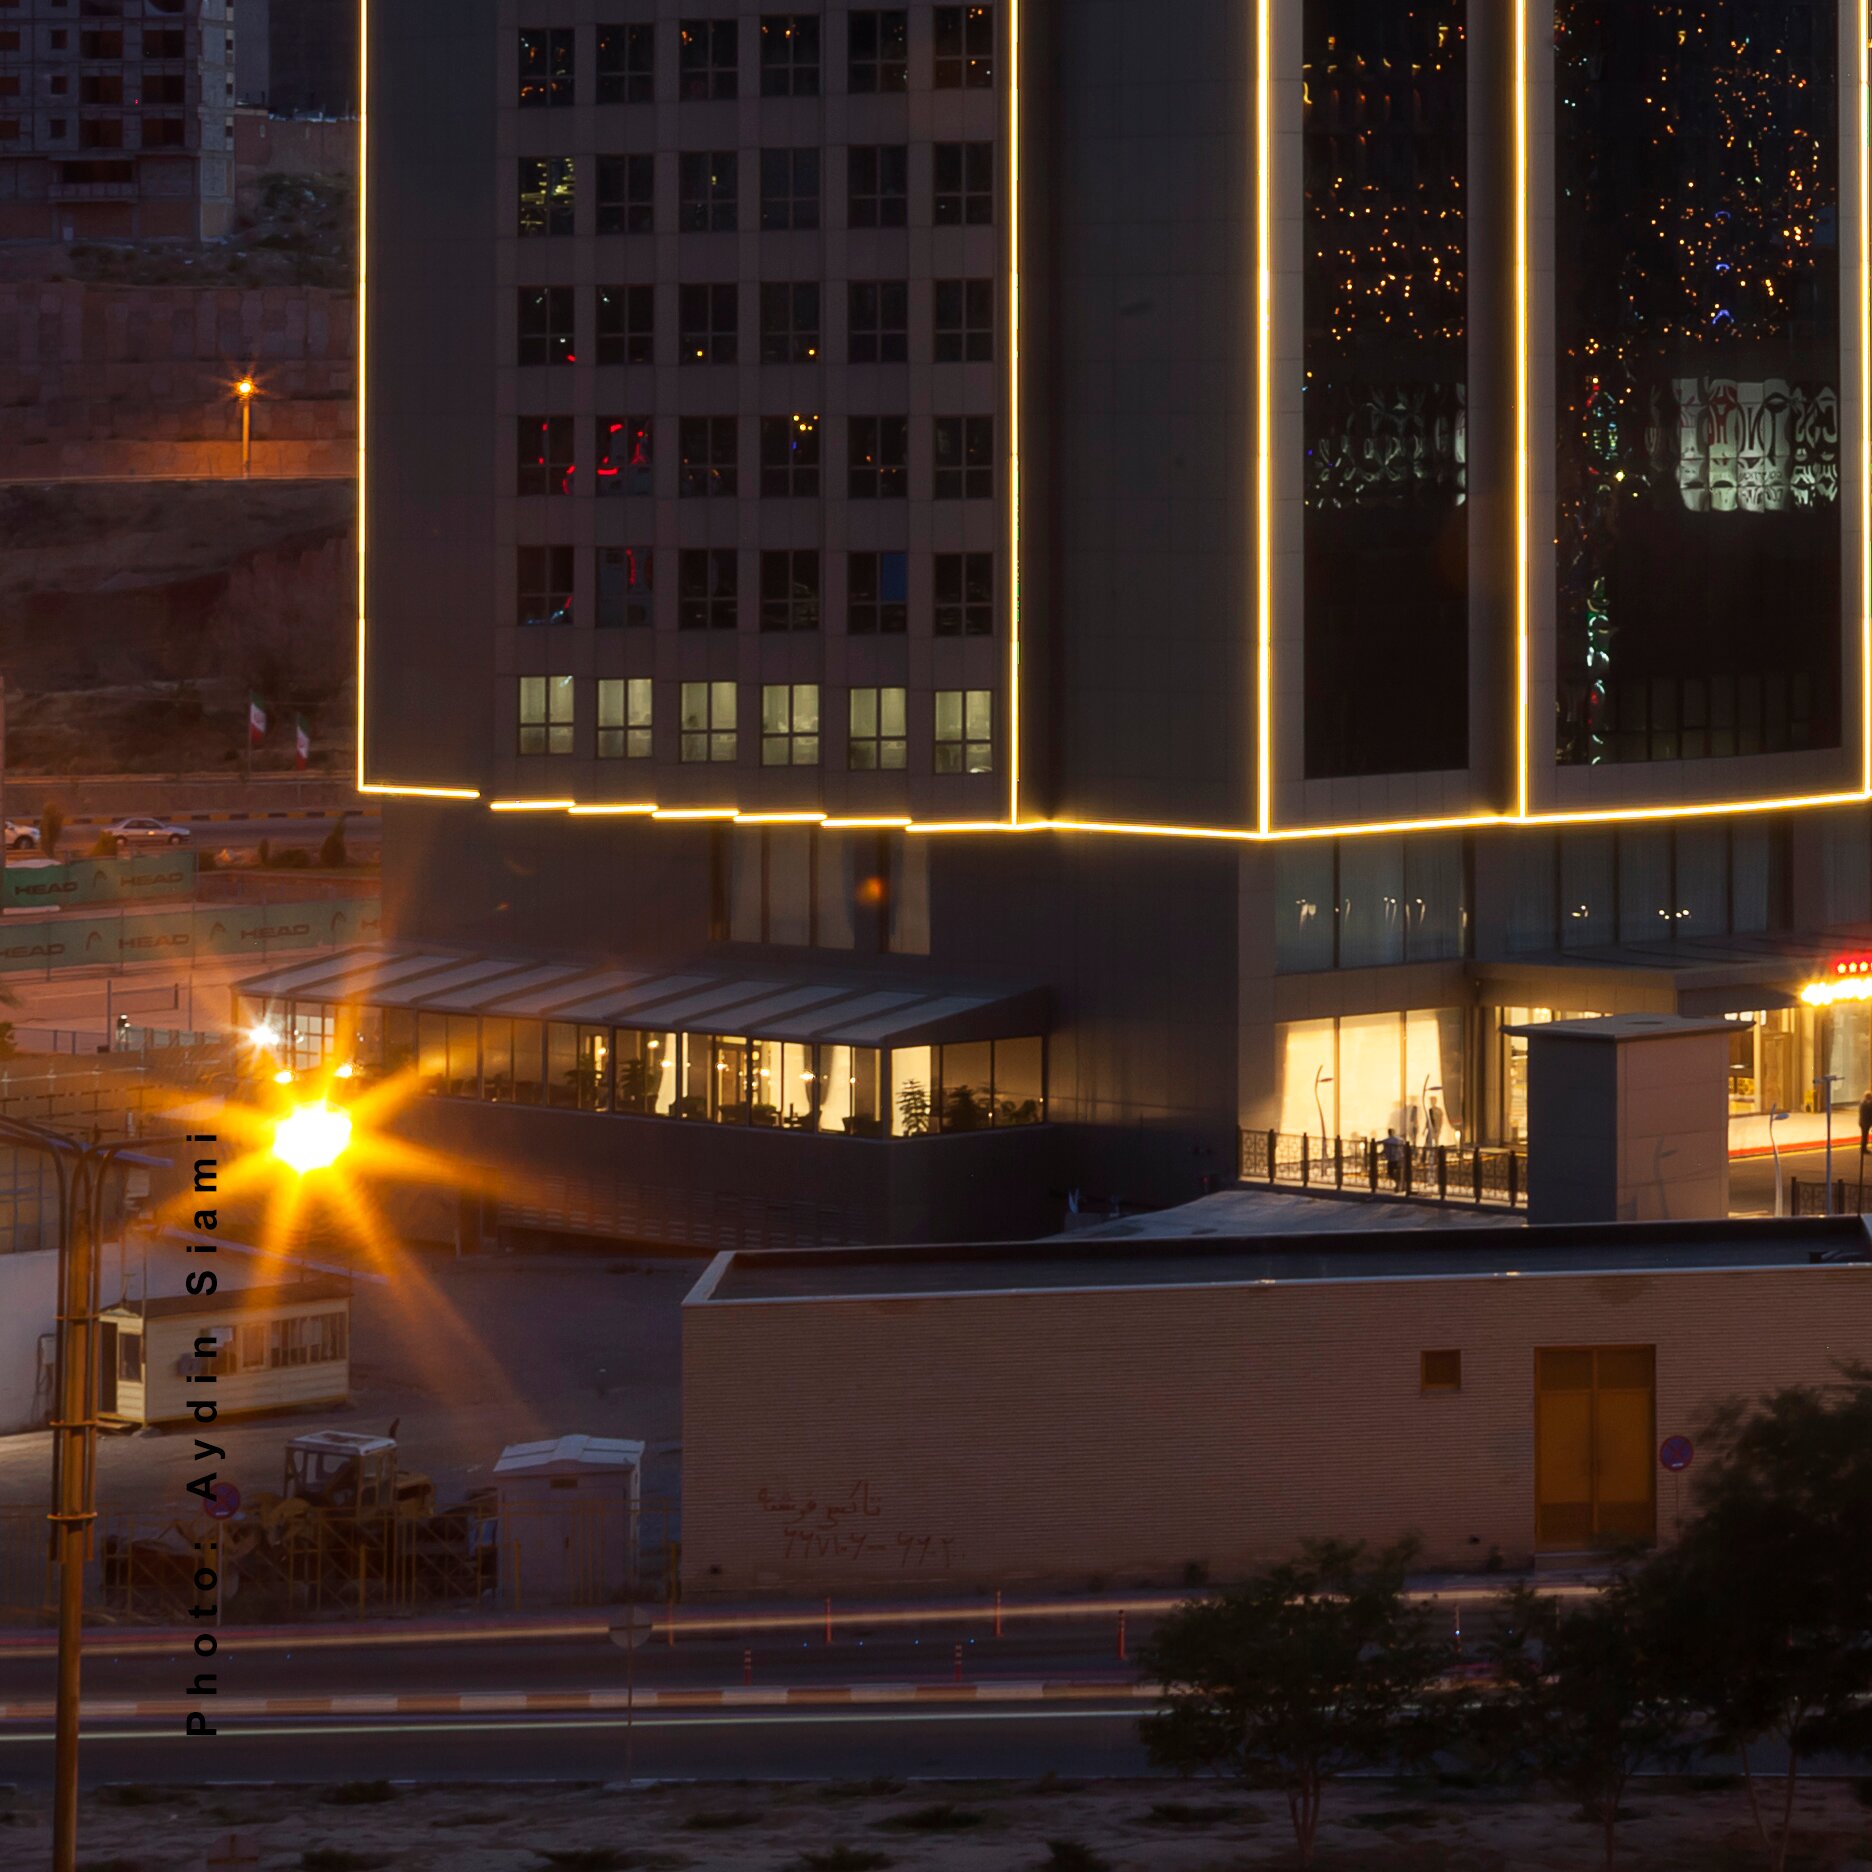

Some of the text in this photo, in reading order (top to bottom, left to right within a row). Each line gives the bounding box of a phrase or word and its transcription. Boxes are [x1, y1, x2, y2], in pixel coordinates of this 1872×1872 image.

[121, 872, 184, 887] HEAD
[15, 881, 78, 896] HEAD
[241, 924, 310, 940] HEAD
[118, 933, 190, 950] HEAD
